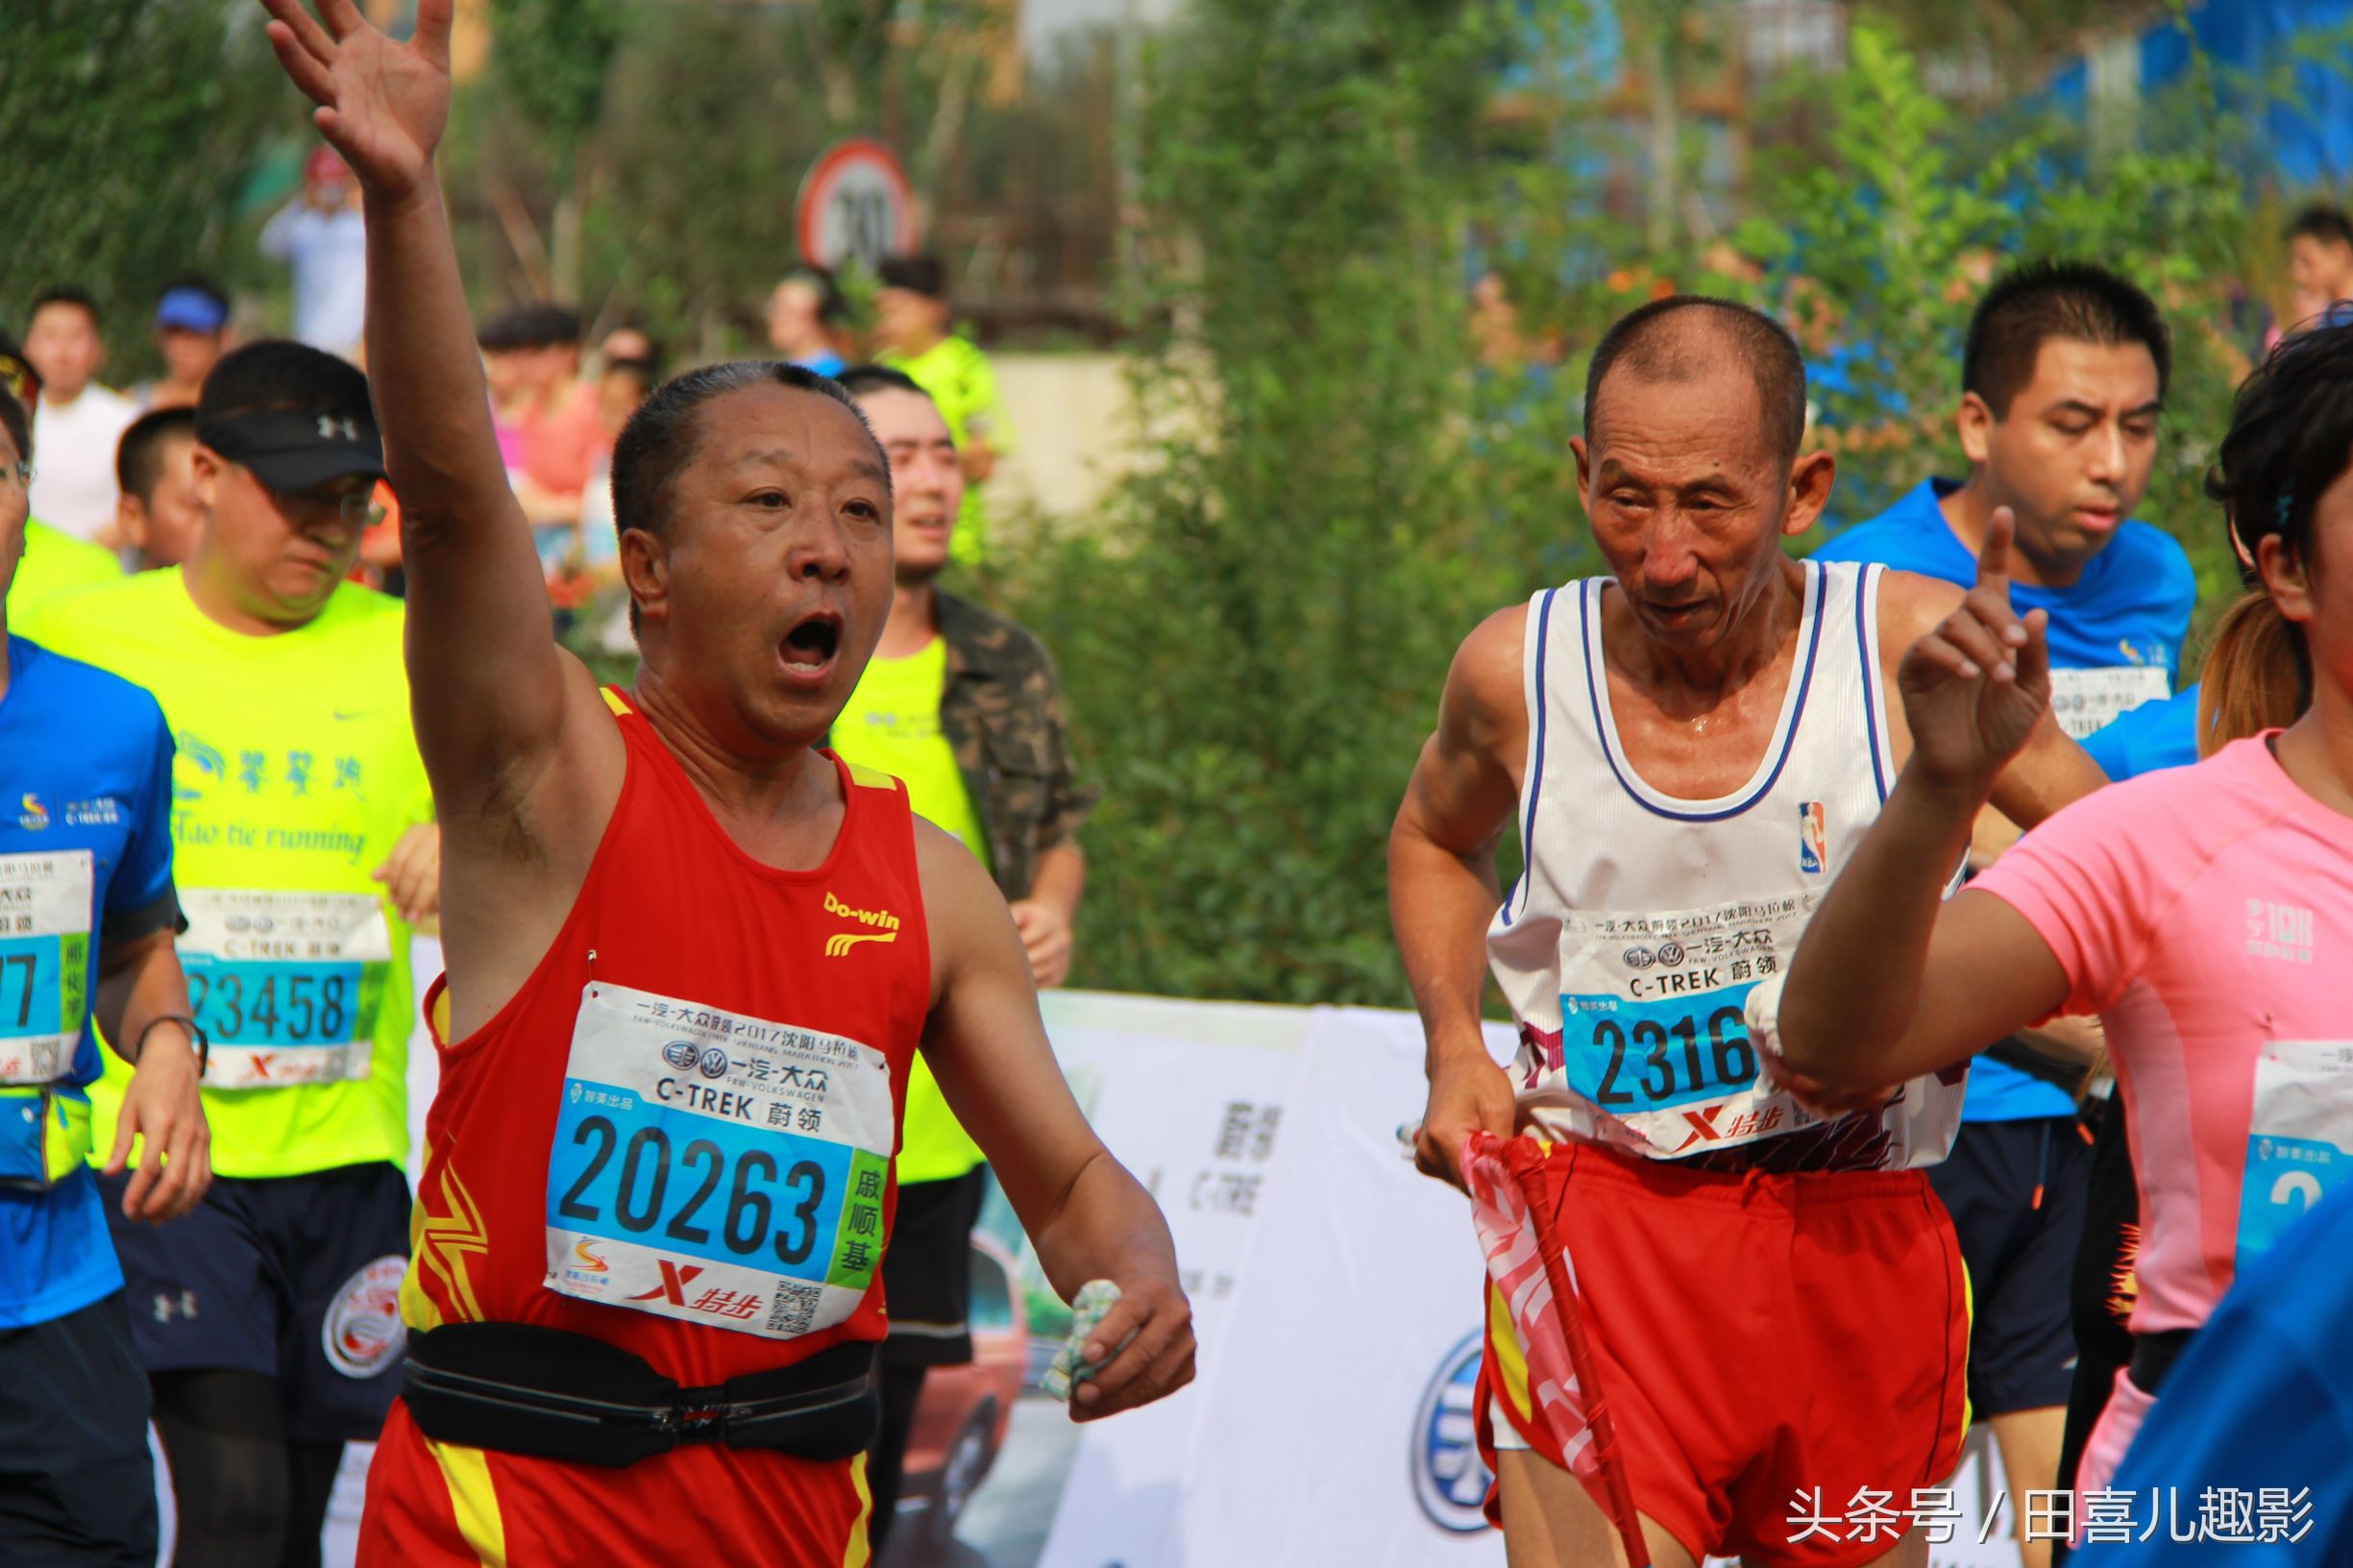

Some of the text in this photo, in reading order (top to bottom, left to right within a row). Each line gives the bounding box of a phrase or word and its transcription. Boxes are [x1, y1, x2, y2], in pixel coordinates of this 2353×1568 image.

[227, 819, 257, 846] tie
[265, 823, 366, 865] running
[823, 891, 900, 931] Do-win
[0, 952, 37, 1027] 7
[187, 971, 345, 1040] 23458
[1630, 968, 1721, 997] C-TREK
[656, 1077, 822, 1134] C-TREK 蔚领
[559, 1115, 826, 1265] 20263
[689, 1287, 766, 1321] 特步
